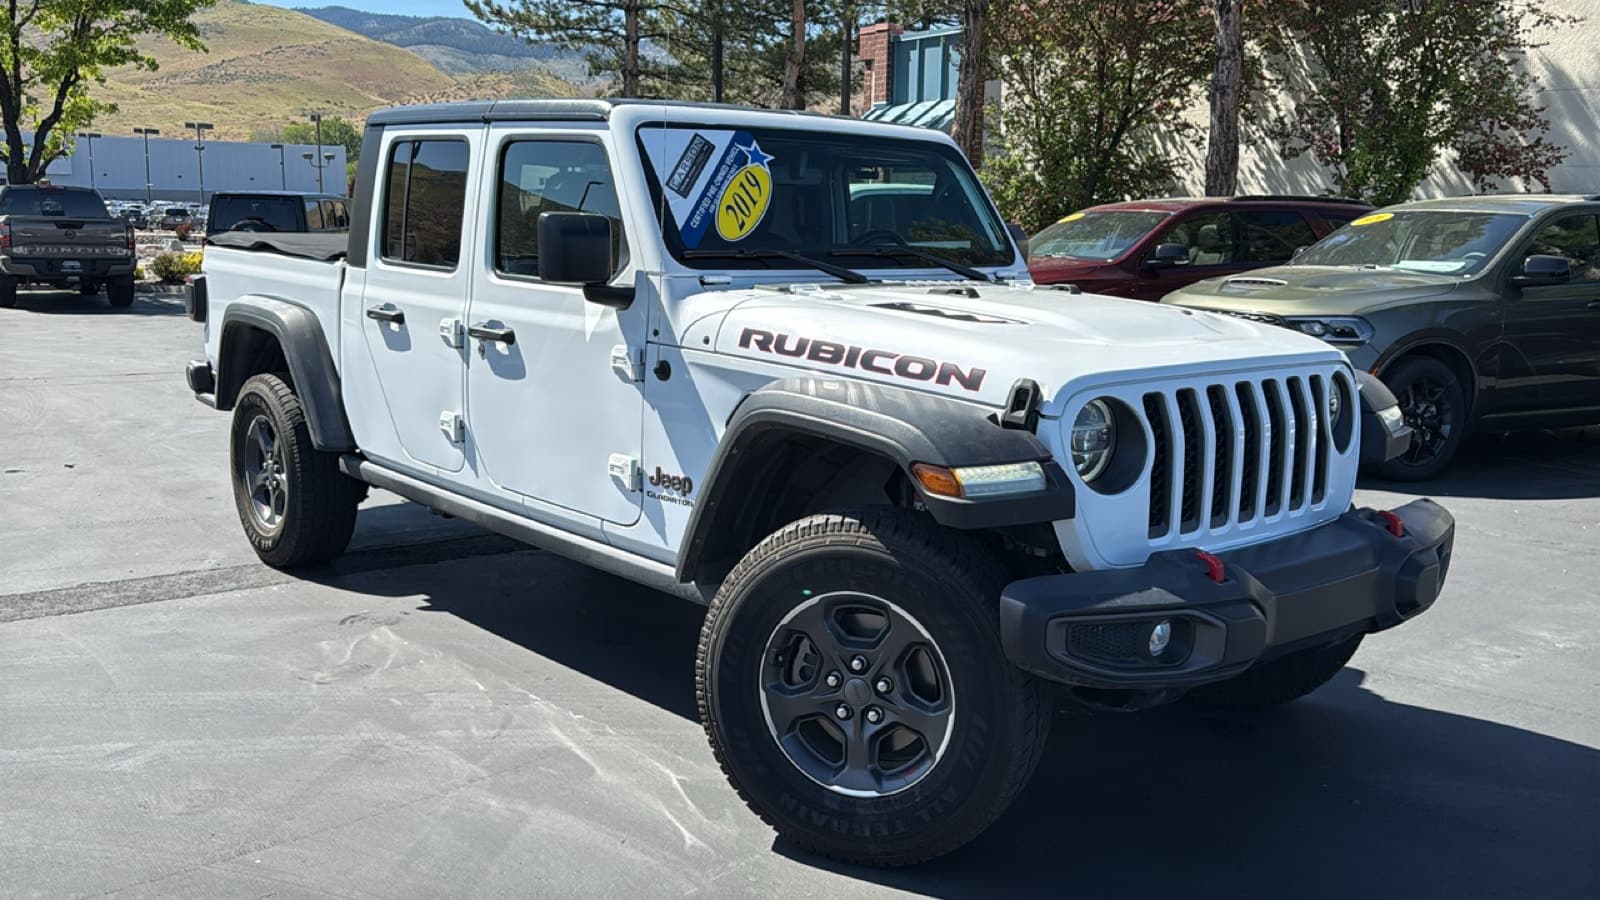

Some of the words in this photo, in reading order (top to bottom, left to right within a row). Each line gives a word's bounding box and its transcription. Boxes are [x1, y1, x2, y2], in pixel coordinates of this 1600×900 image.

[671, 138, 704, 189] CARSON
[690, 195, 711, 228] CERTIFIED
[706, 163, 729, 199] PRE-OWNED
[726, 170, 762, 232] 2019
[738, 327, 987, 393] RUBICON
[647, 490, 695, 508] GLADIATOR
[649, 466, 693, 497] Jeep
